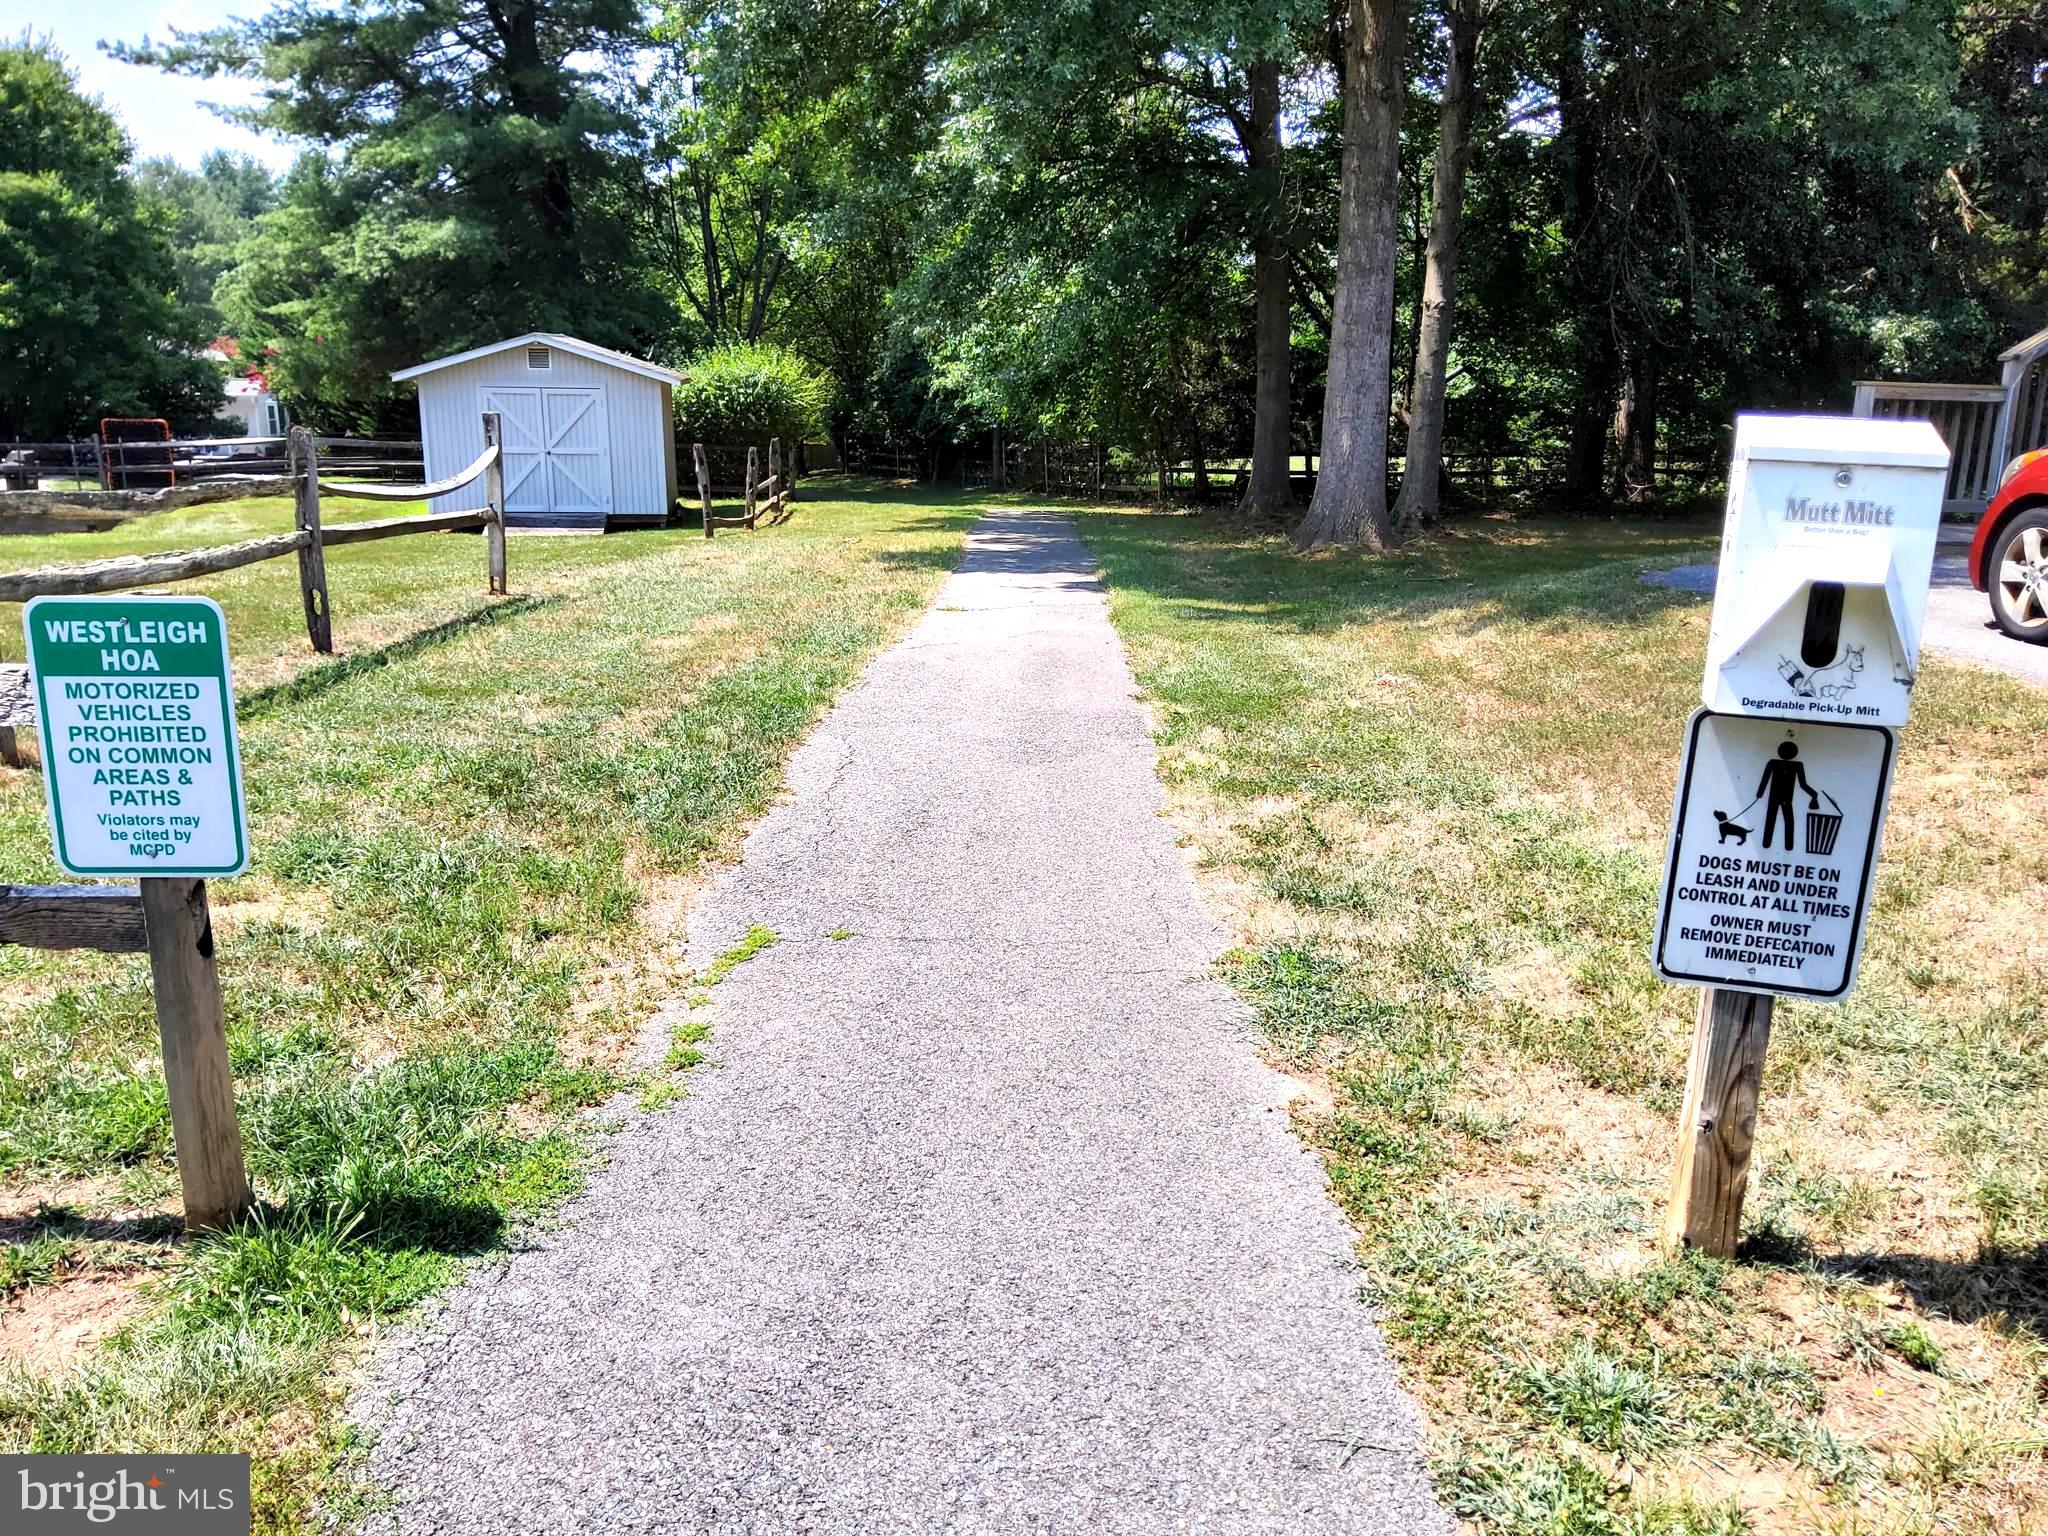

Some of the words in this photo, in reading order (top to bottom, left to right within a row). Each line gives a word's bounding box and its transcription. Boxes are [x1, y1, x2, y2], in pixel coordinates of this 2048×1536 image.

[1784, 497, 1839, 524] Mutt
[1843, 499, 1895, 527] Mitt
[44, 620, 207, 643] WESTLEIGH
[100, 649, 160, 671] HOA
[65, 682, 200, 699] MOTORIZED
[78, 704, 191, 721] VEHICLES
[1742, 697, 1805, 711] Degradable
[1809, 702, 1852, 715] Pick-Up
[1856, 705, 1880, 717] Mitt
[68, 726, 207, 743] PROHIBITED
[68, 747, 100, 764] ON
[108, 747, 212, 764] COMMON
[93, 768, 170, 785] AREAS
[178, 768, 193, 785] &
[110, 789, 181, 806] PATHS
[97, 813, 165, 826] Violators
[170, 816, 200, 829] may
[110, 829, 129, 841] be
[133, 828, 170, 841] cited
[174, 829, 191, 844] by
[130, 844, 176, 856] MCPD
[1699, 855, 1742, 871] DOGS
[1746, 860, 1791, 877] MUST
[1794, 865, 1814, 880] BE
[1819, 868, 1840, 882] ON
[1696, 871, 1744, 888] LEASH
[1747, 878, 1780, 893] AND
[1784, 881, 1838, 900] UNDER
[1678, 887, 1747, 907] CONTROL
[1750, 896, 1769, 909] AT
[1771, 898, 1798, 913] ALL
[1804, 901, 1850, 918] TIMES
[1710, 914, 1763, 932] OWNER
[1768, 921, 1811, 937] MUST
[1680, 927, 1741, 945] REMOVE
[1744, 934, 1835, 957] DEFECATION
[1705, 946, 1805, 970] IMMEDIATELY
